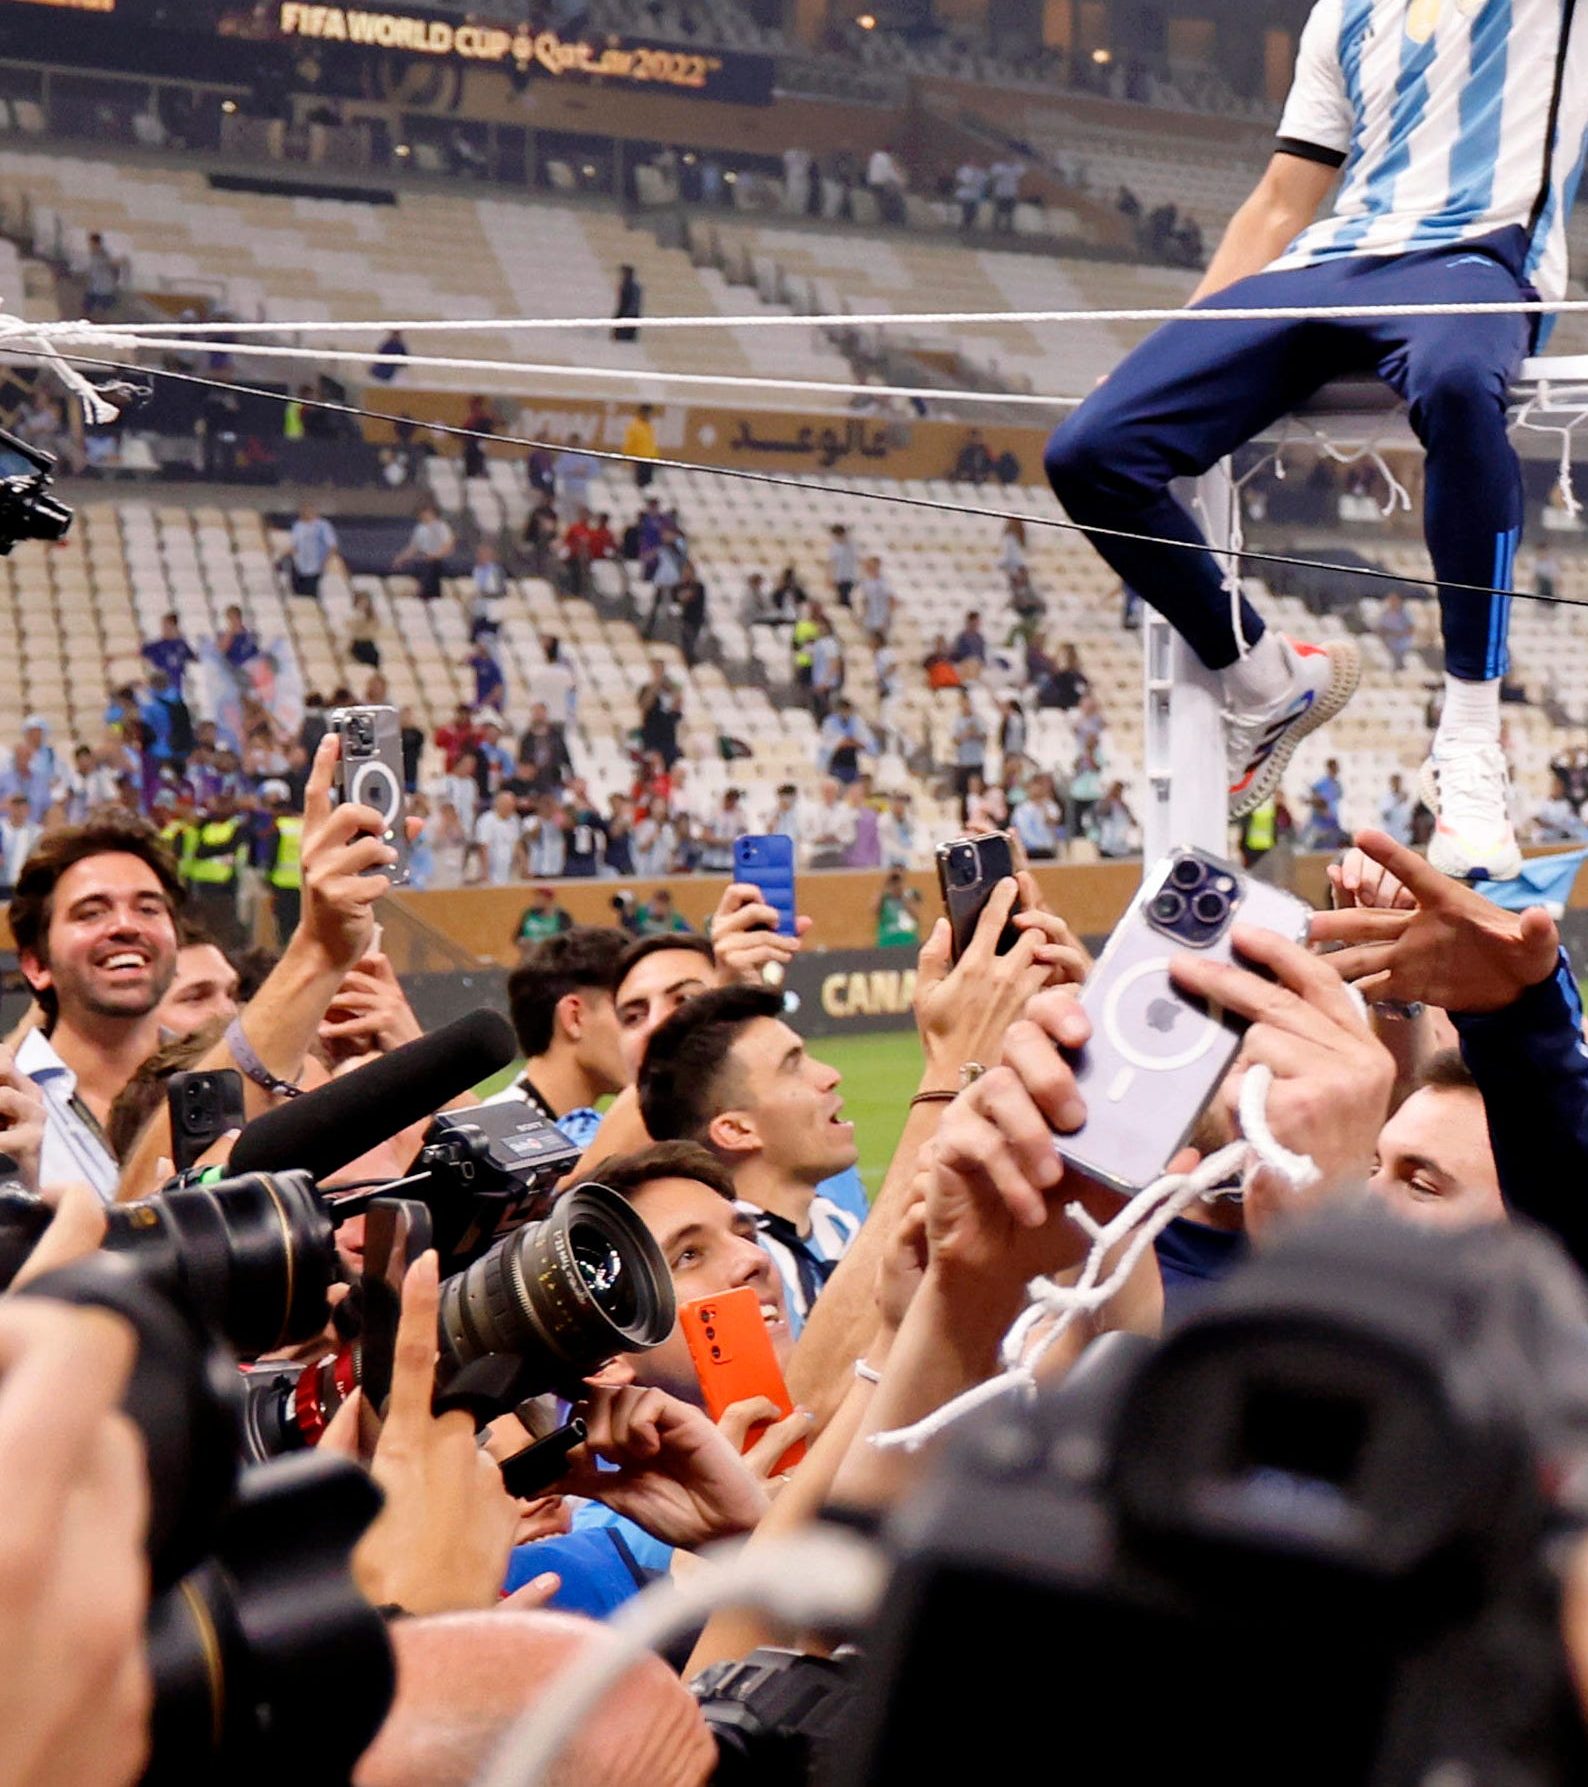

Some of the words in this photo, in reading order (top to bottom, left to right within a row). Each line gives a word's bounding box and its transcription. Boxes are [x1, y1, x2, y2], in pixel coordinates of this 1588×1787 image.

[279, 0, 346, 40] FIFA
[347, 9, 455, 55] WORLD
[454, 25, 512, 61] CUP
